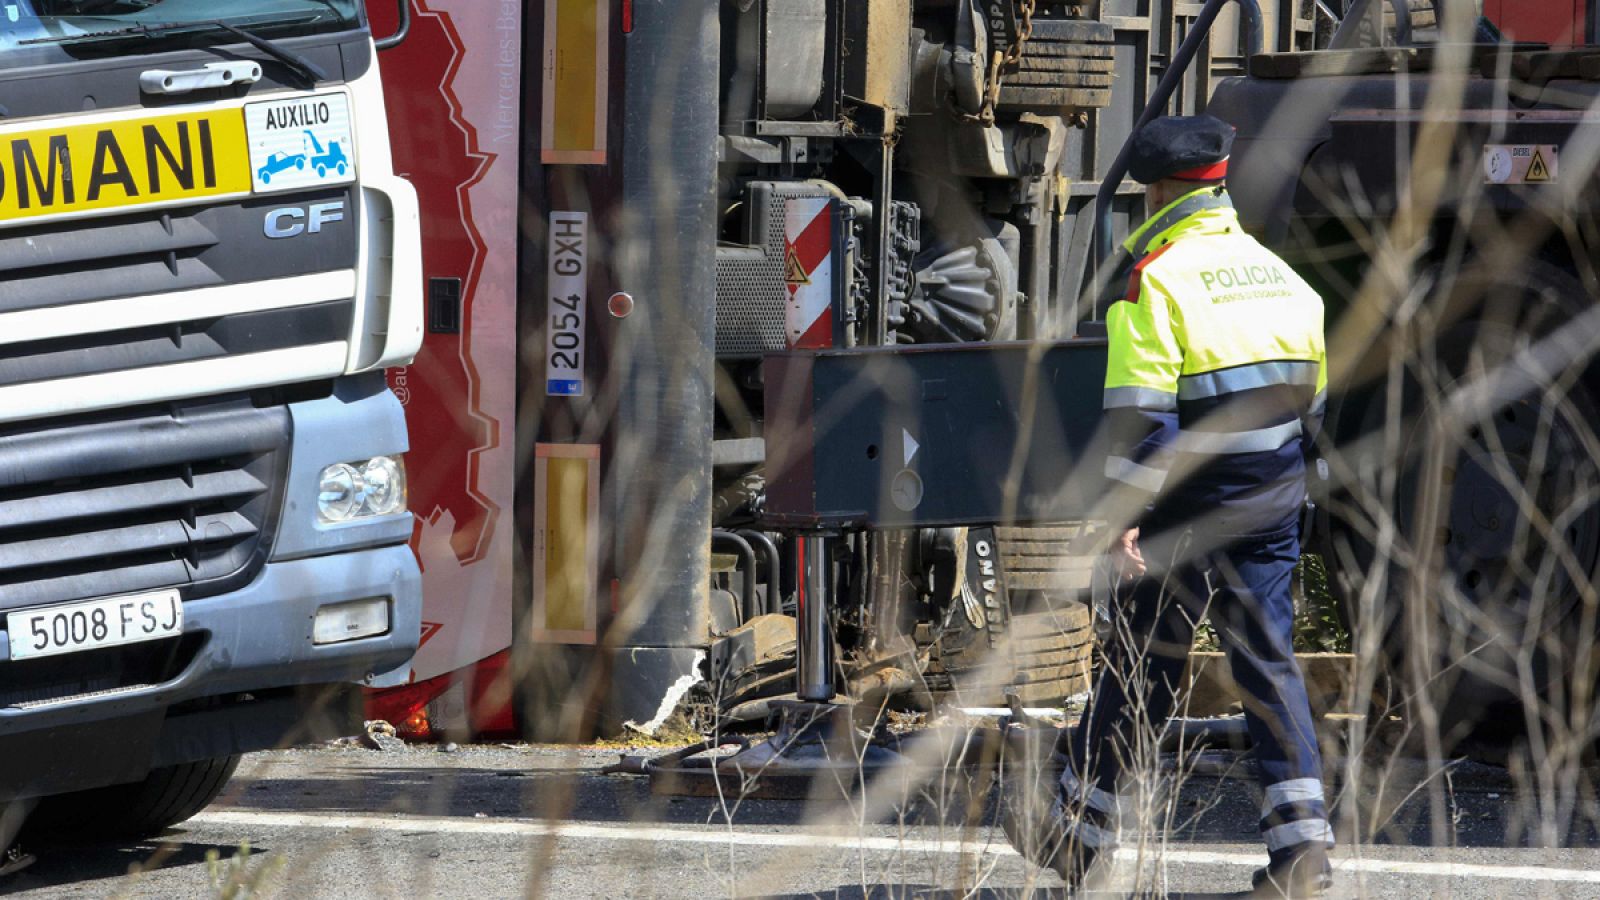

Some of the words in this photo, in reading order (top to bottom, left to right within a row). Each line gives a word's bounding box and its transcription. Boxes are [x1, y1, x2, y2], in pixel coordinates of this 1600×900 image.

[493, 0, 517, 144] Mercedes-Be
[266, 102, 330, 130] AUXILIO
[0, 119, 216, 209] MANI
[263, 201, 345, 239] CF
[554, 219, 583, 277] GXH
[1200, 266, 1287, 292] POLICIA
[550, 293, 581, 370] 2054
[30, 607, 108, 650] 5008
[119, 596, 178, 638] FSJ
